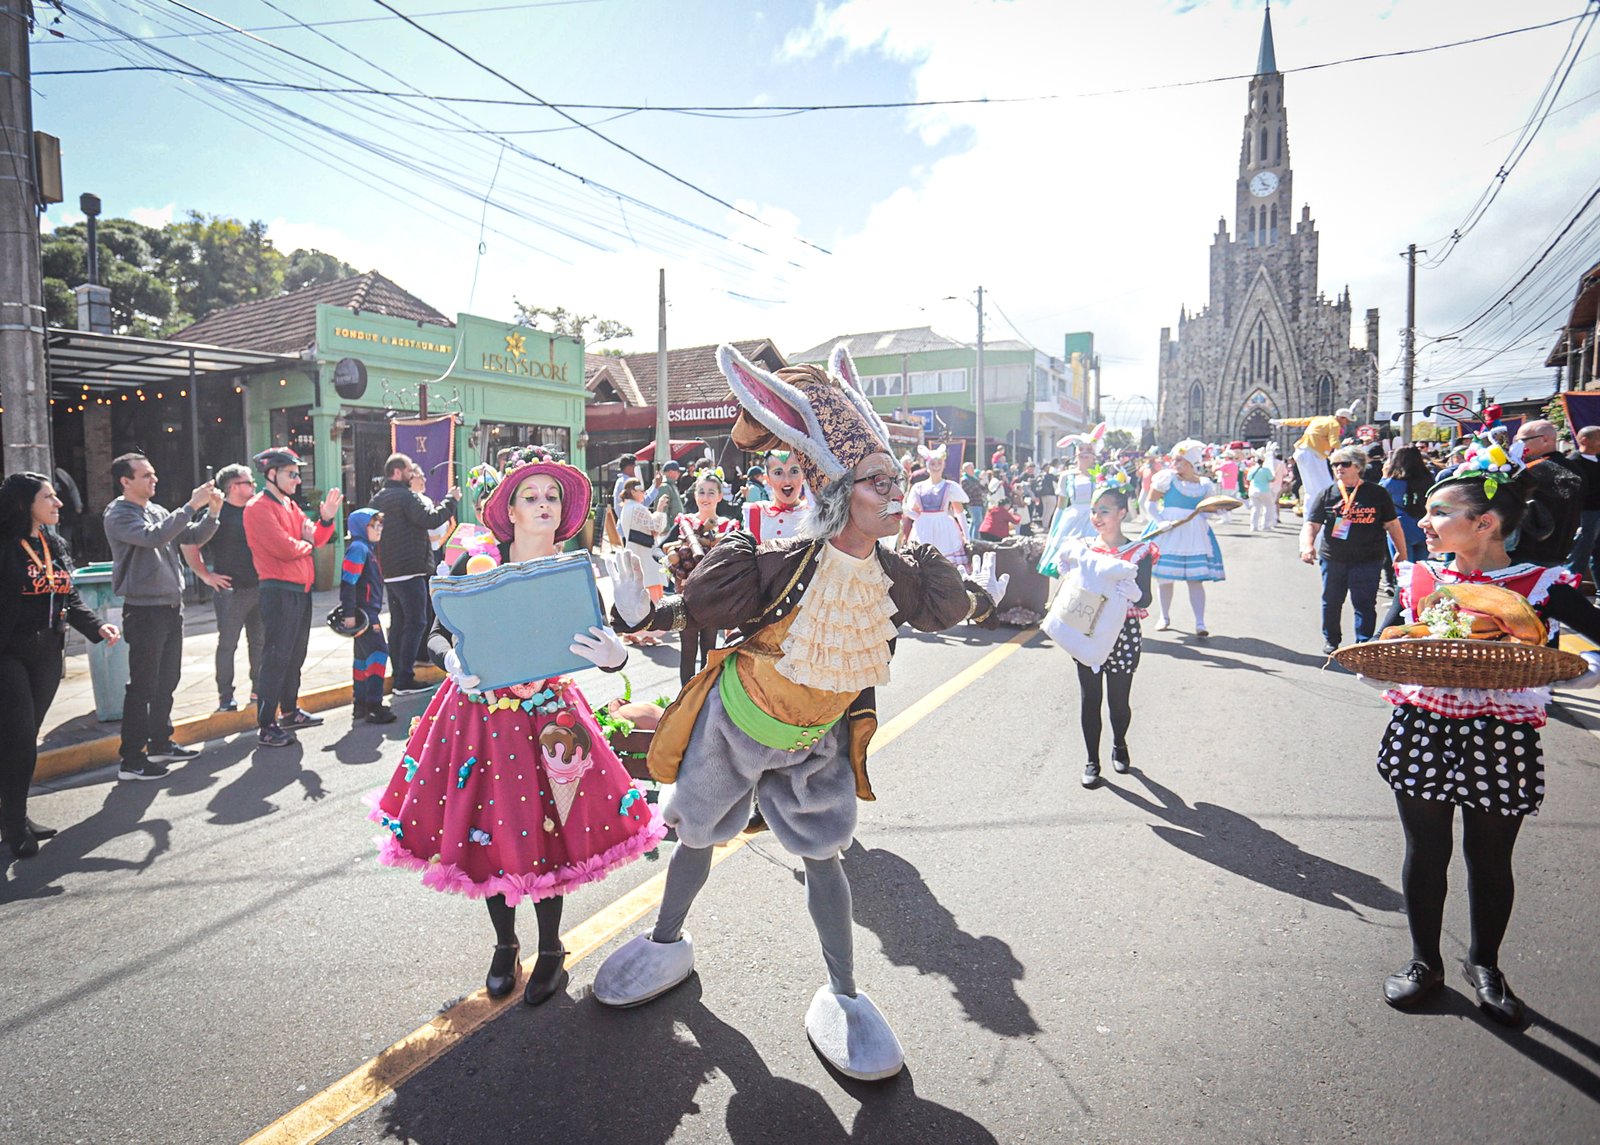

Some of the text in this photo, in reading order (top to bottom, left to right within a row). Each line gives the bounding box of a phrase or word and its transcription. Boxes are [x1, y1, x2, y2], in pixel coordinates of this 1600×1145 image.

[335, 327, 378, 342] FONDUE
[392, 336, 452, 353] RESTAURANT
[667, 404, 737, 421] estaurante
